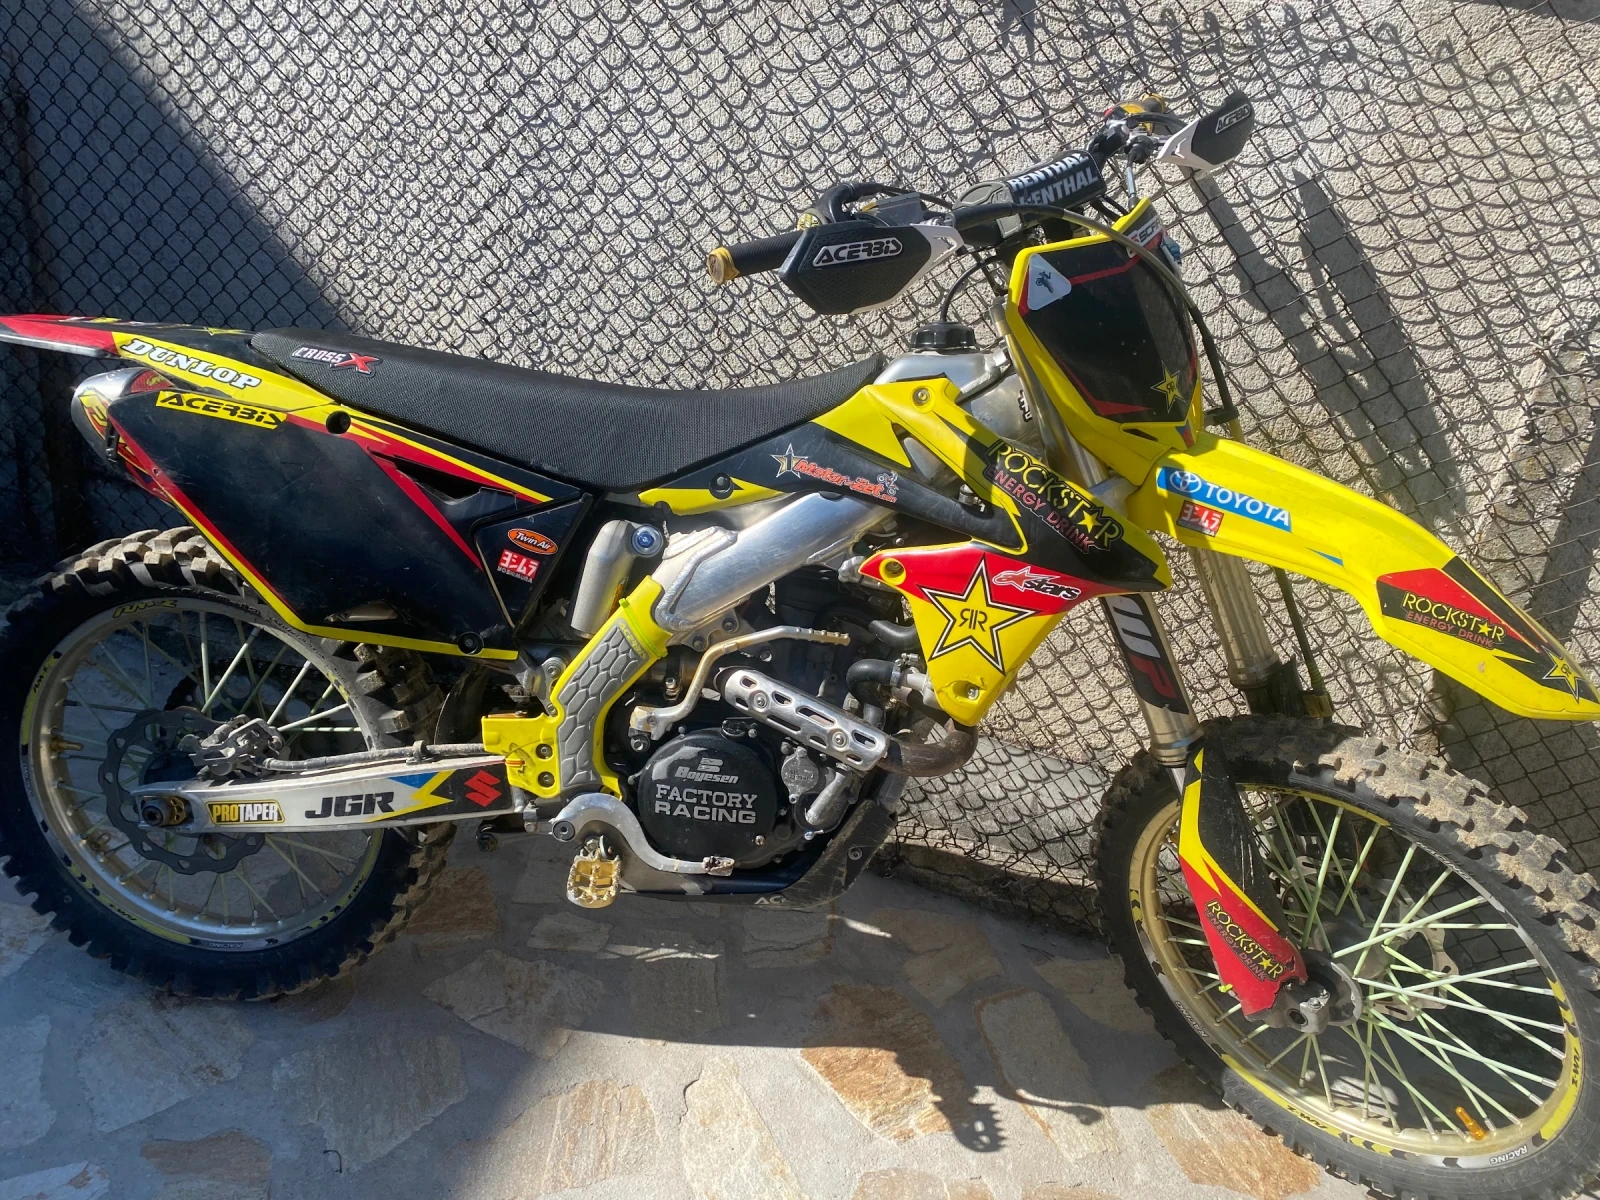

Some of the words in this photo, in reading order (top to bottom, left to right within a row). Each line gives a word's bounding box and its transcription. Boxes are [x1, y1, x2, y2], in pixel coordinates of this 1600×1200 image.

[1006, 153, 1090, 192] RENTHAL
[120, 338, 262, 389] DUNLOP
[291, 346, 347, 362] CROSS
[1205, 482, 1290, 527] TOYOTA
[515, 531, 538, 545] Twin
[536, 541, 552, 550] Air
[1045, 511, 1095, 554] DRINK
[1407, 611, 1455, 632] ENERGY
[1458, 629, 1494, 648] DRINK
[675, 766, 739, 784] Boyesen
[304, 791, 396, 819] JGR
[656, 784, 758, 809] FACTORY
[655, 800, 757, 824] RACING
[1489, 1144, 1529, 1166] RACING
